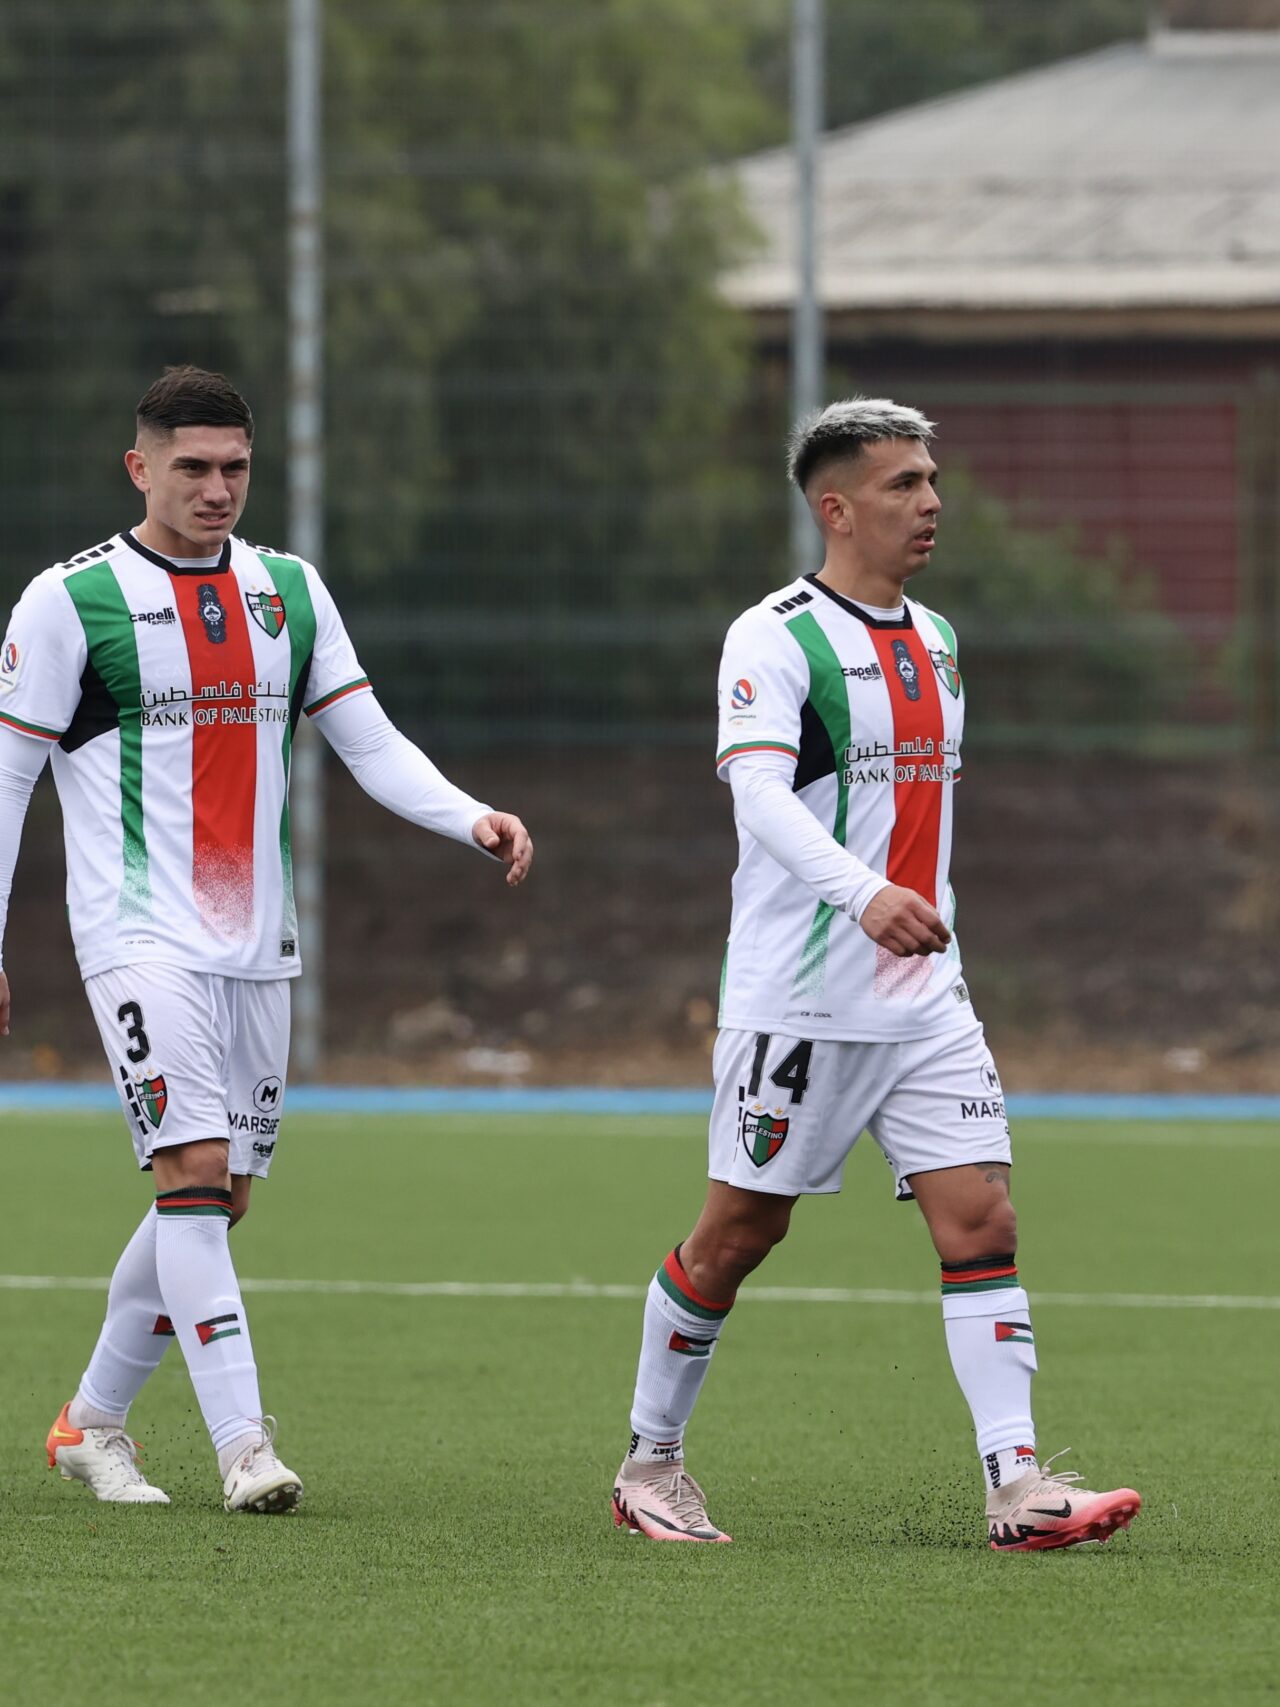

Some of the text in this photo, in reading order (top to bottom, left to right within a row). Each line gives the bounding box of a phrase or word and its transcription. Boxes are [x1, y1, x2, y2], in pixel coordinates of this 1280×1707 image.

[129, 606, 176, 624] capelli
[841, 662, 881, 680] capelli
[141, 680, 242, 710] فلسطين
[141, 707, 289, 727] BANK OF PALESTINE
[843, 767, 891, 786] BANK
[894, 764, 917, 784] OF
[117, 1000, 152, 1064] 3
[747, 1032, 815, 1106] 14
[261, 1085, 278, 1103] M
[745, 1124, 784, 1139] PALESTINO
